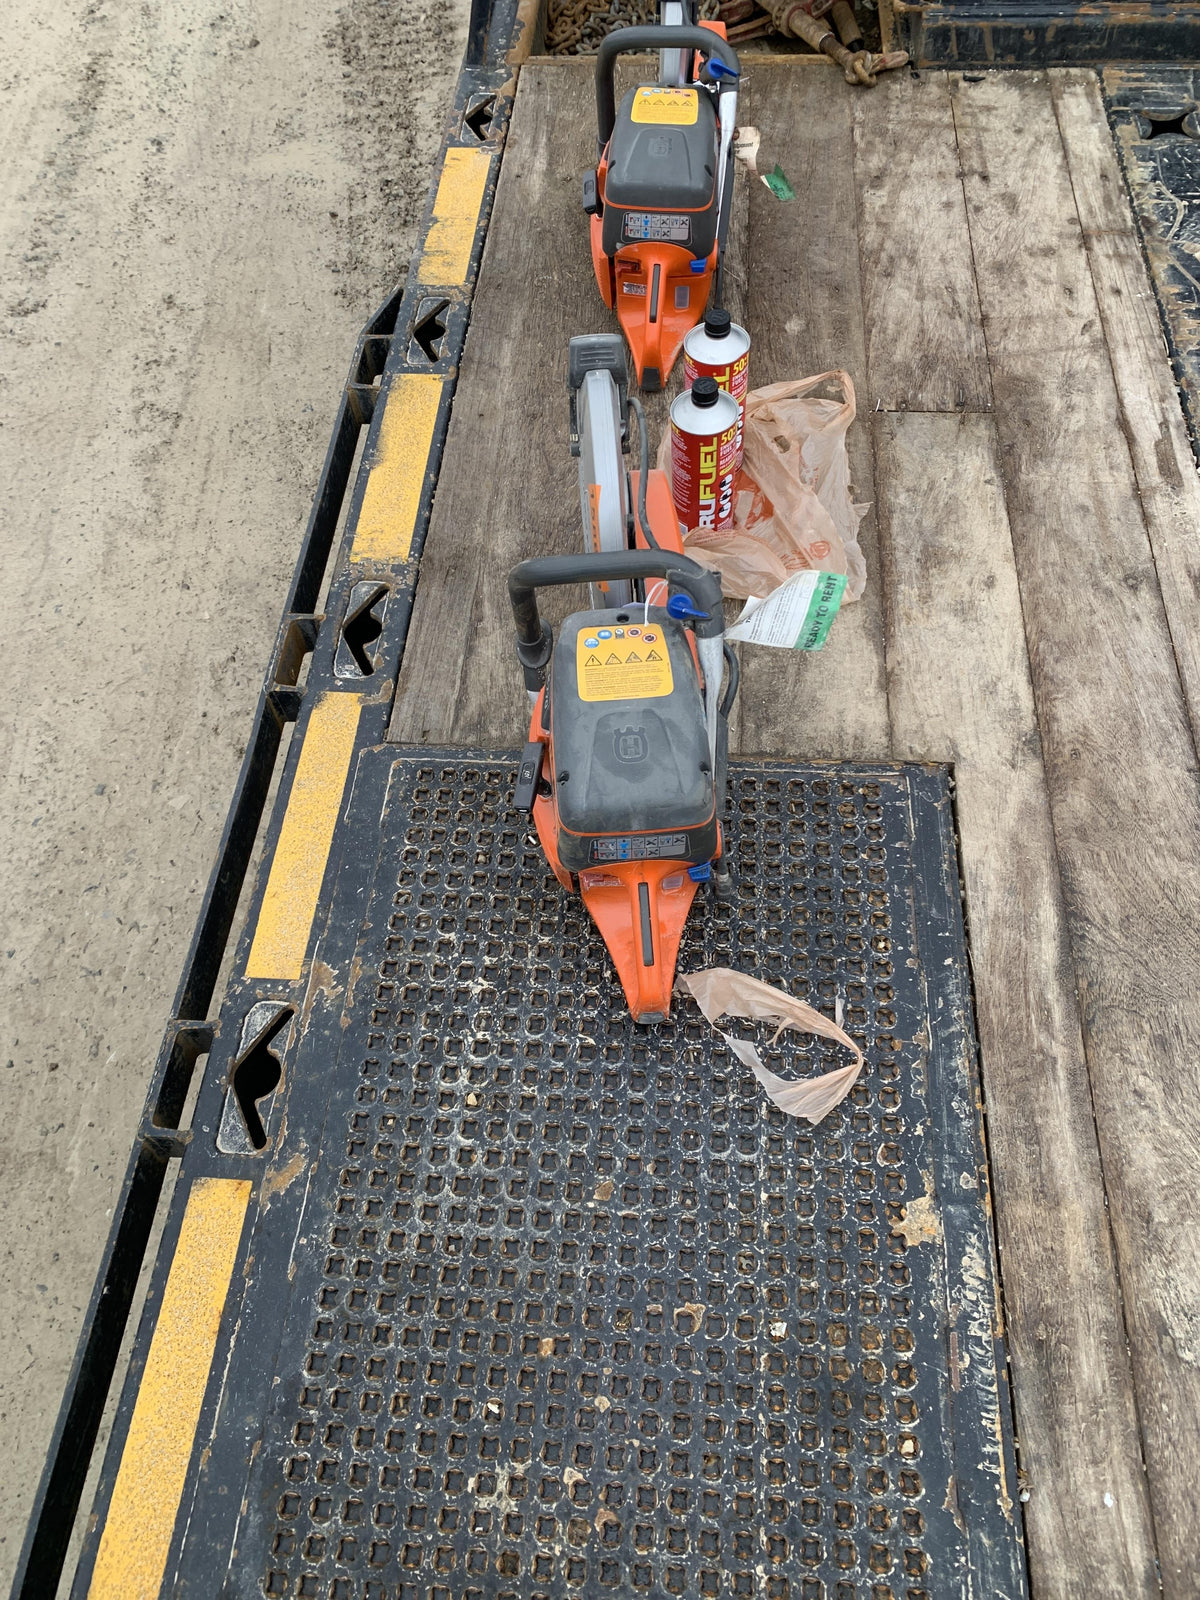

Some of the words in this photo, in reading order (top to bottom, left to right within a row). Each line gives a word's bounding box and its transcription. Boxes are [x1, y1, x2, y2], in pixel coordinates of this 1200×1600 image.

[698, 436, 718, 531] RUFUEL
[822, 575, 838, 603] RENT
[816, 604, 829, 619] TO
[803, 619, 823, 649] READY
